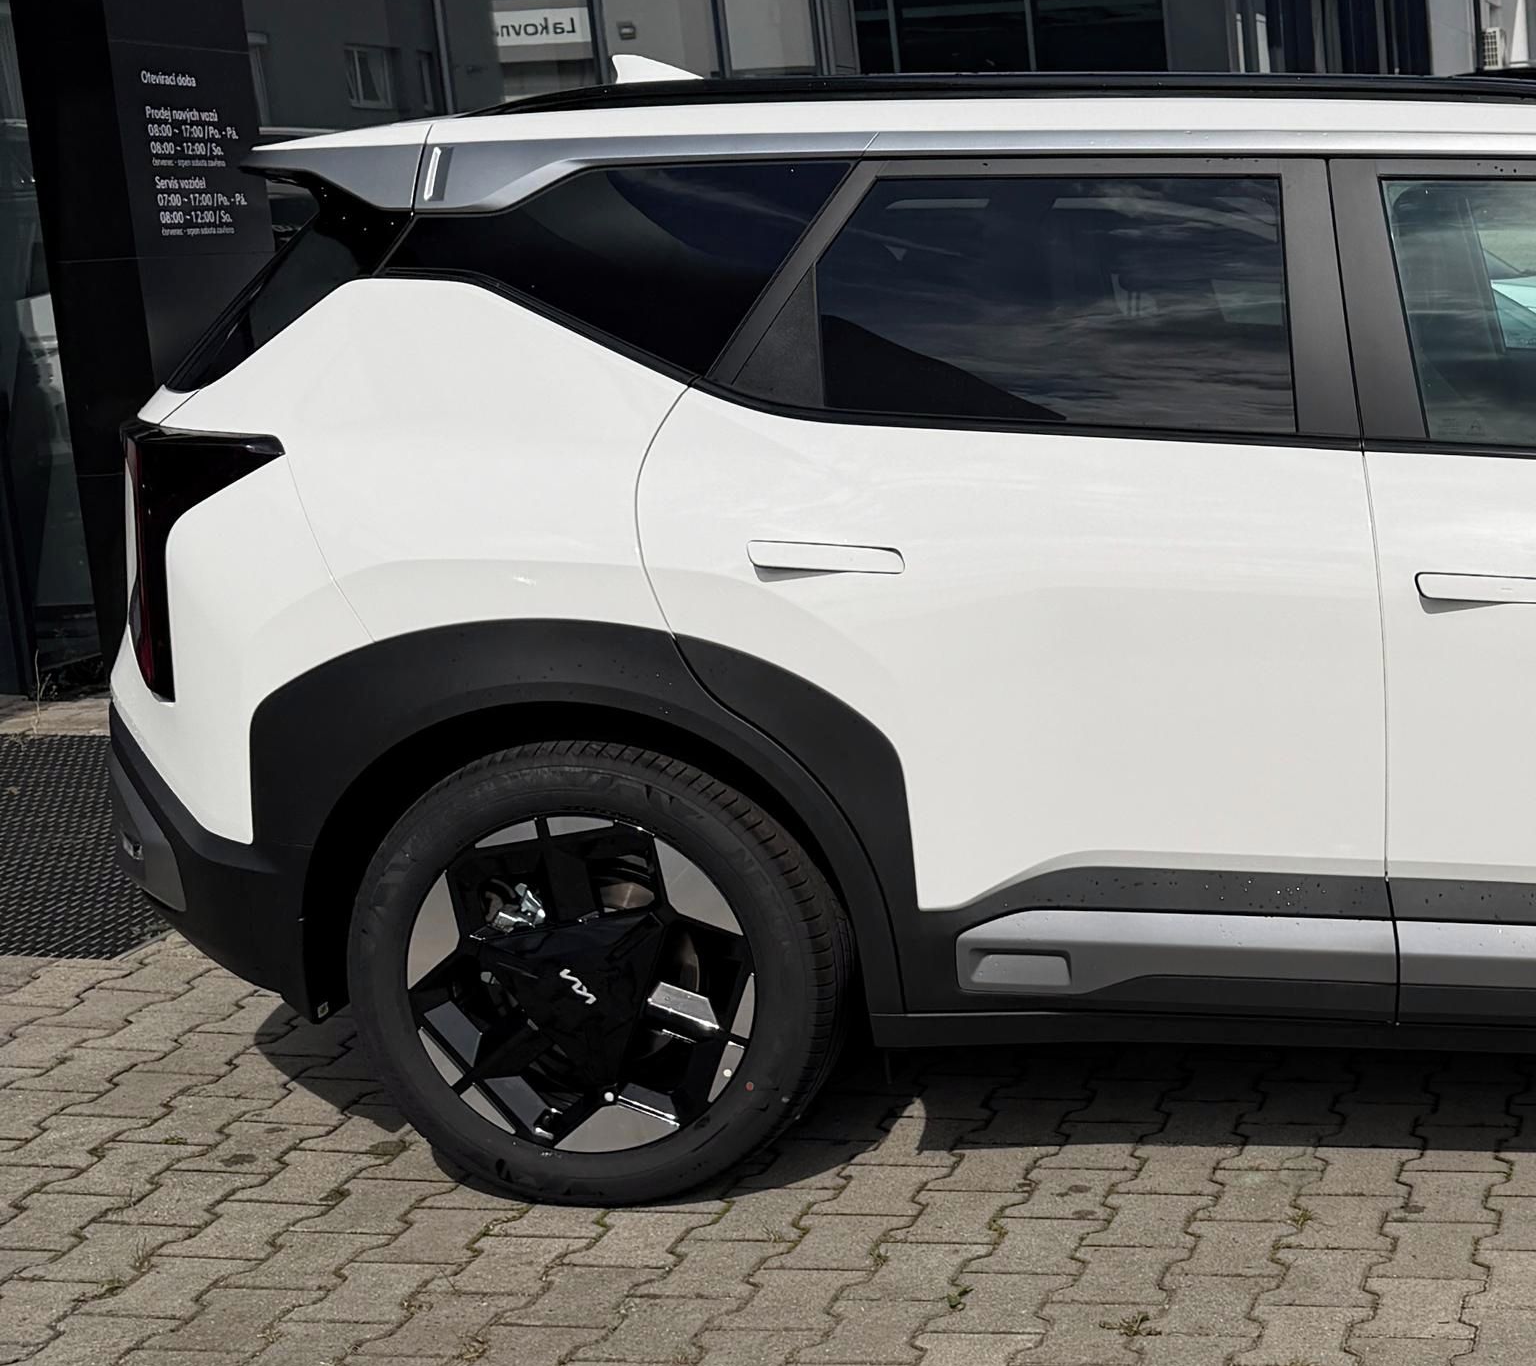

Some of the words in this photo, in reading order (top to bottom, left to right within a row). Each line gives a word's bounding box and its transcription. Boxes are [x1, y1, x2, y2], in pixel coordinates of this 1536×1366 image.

[177, 74, 197, 87] doba
[145, 105, 172, 122] Prodej
[172, 108, 199, 123] nových
[148, 124, 172, 137] 08:00
[181, 125, 203, 137] 17:00
[150, 141, 175, 154] 08:00
[183, 142, 206, 154] 12:00
[155, 176, 178, 189] Servis
[180, 177, 206, 189] vozidel
[157, 194, 182, 206] 07:00
[190, 194, 213, 206] 17:00
[160, 212, 184, 224] 08:00
[191, 211, 215, 223] 12:00
